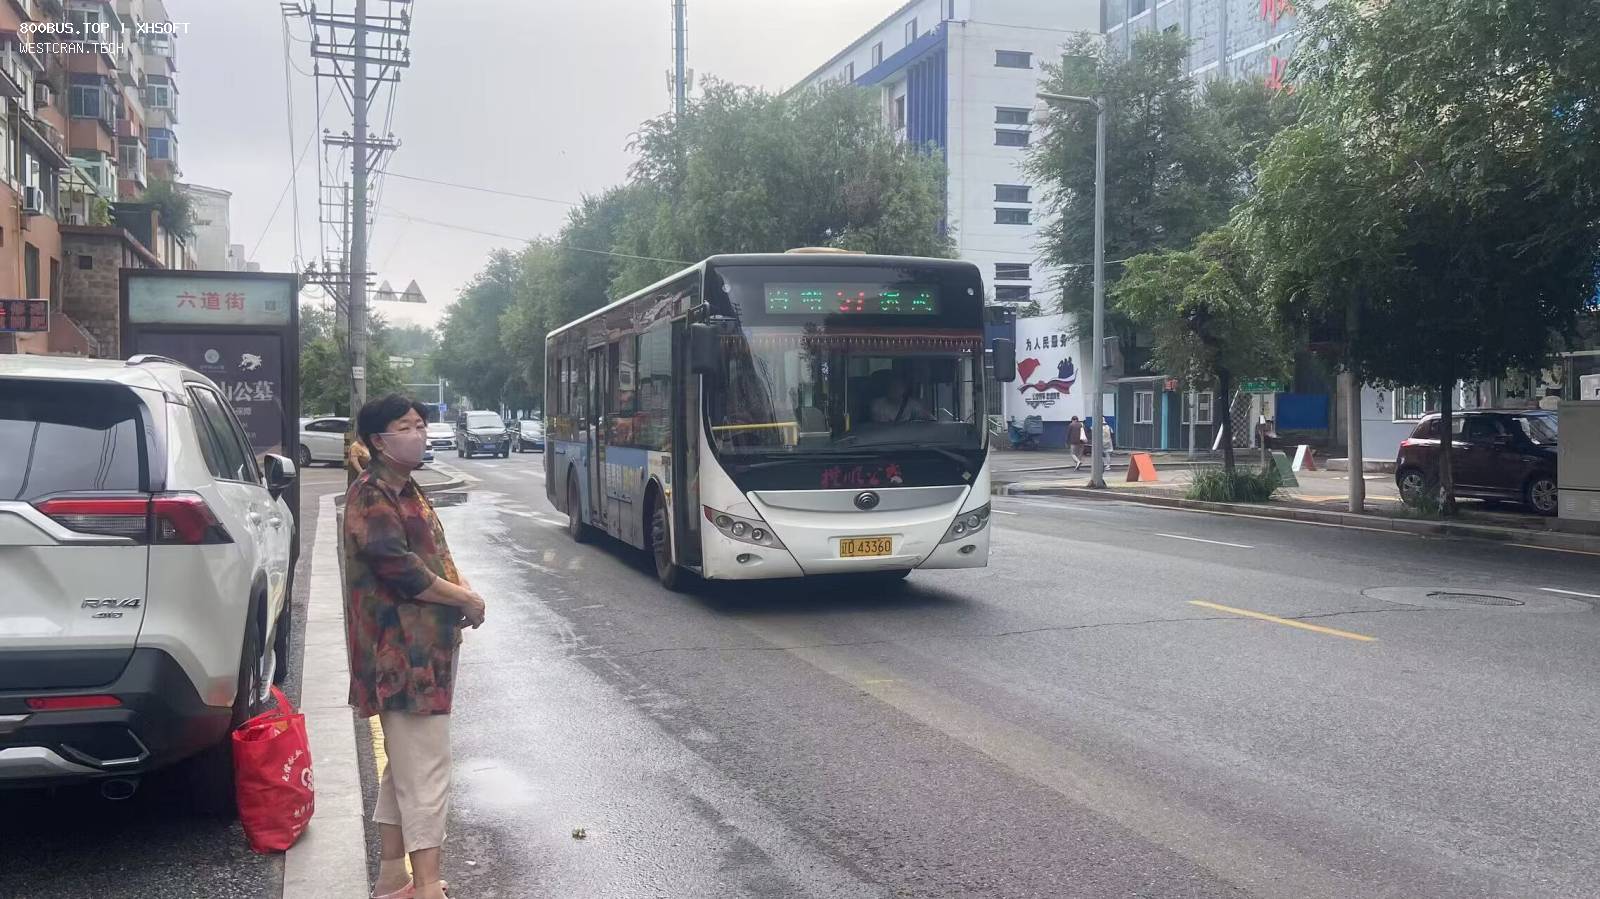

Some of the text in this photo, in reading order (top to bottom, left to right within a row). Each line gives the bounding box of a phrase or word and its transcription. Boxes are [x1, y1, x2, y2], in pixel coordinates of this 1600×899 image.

[176, 291, 246, 312] 六道街
[1025, 334, 1068, 351] 为人民服务
[81, 597, 142, 609] RAV4
